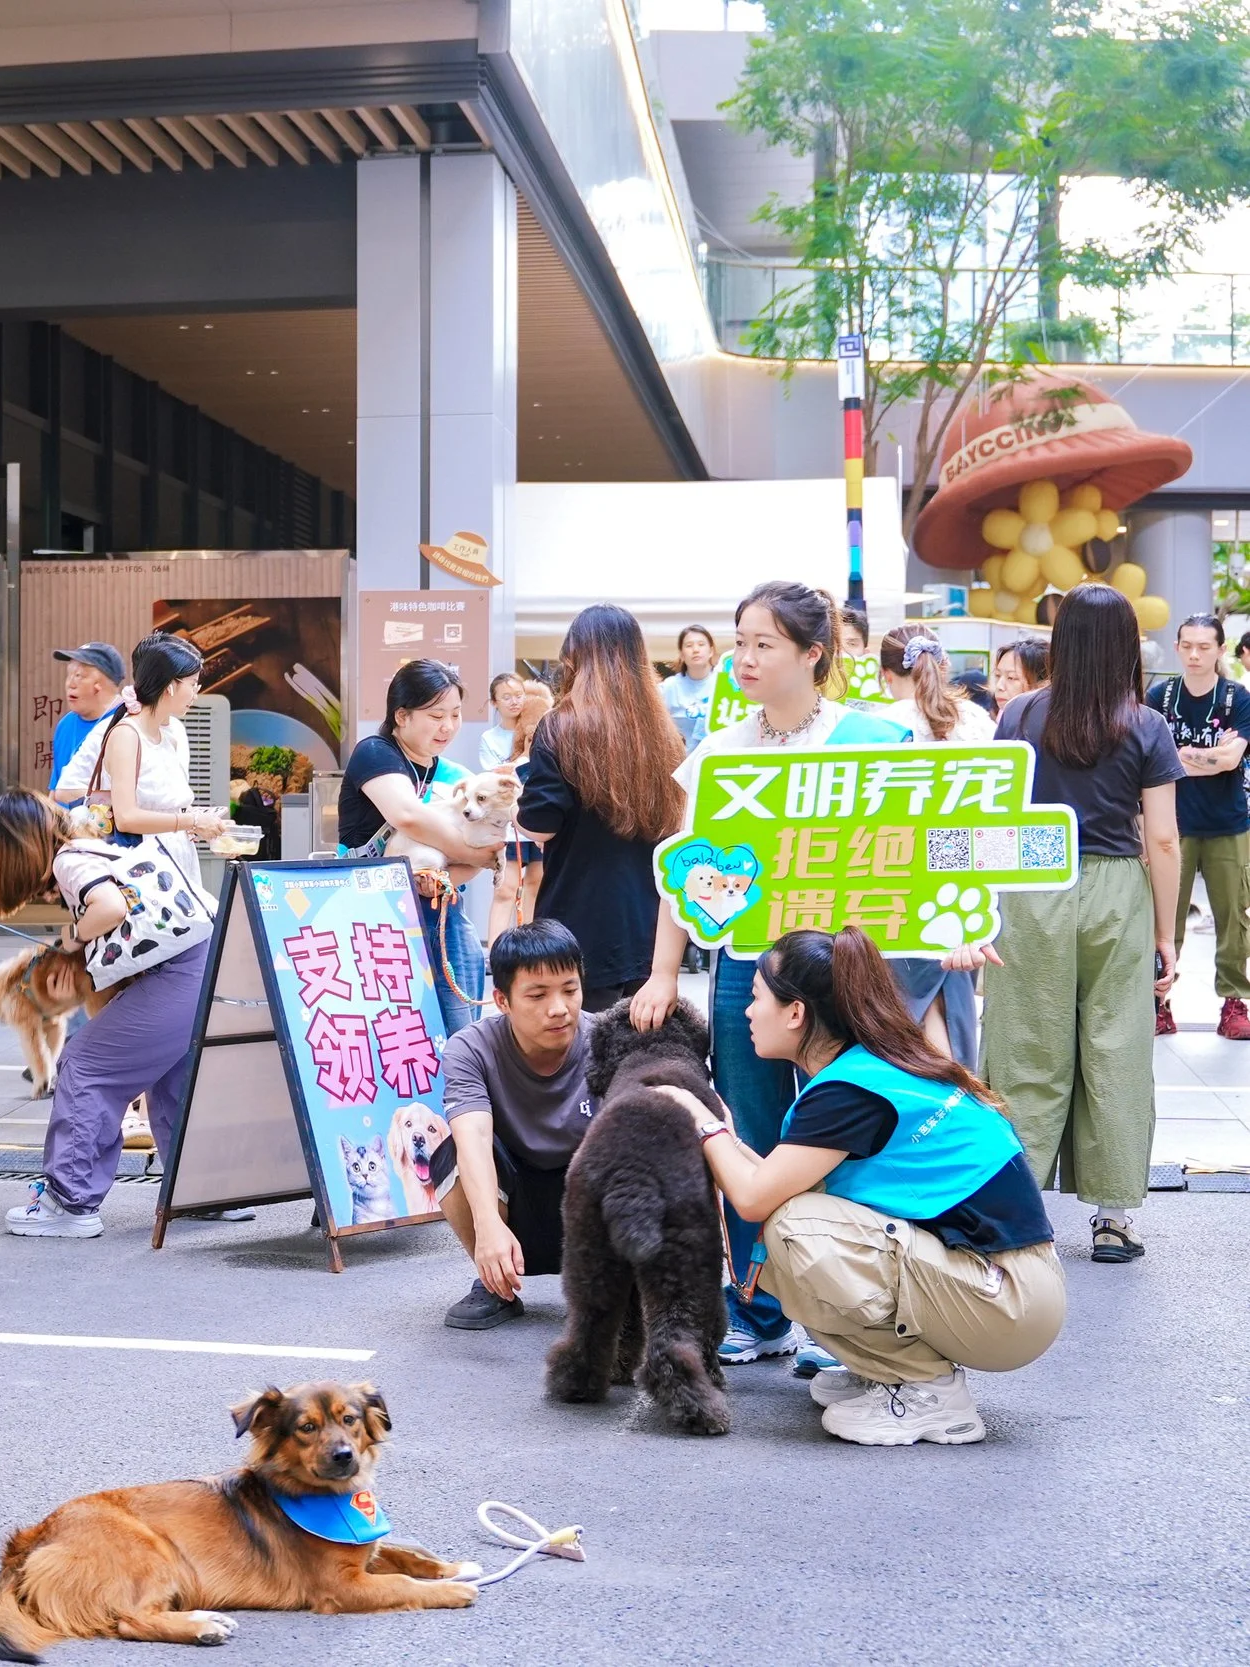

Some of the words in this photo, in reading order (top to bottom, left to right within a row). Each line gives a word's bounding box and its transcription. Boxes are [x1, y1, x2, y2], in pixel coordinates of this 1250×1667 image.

[710, 758, 1015, 821] 文明养宠
[771, 825, 917, 880] 拒绝
[766, 888, 913, 942] 遗弃
[283, 922, 414, 1009] 支持
[305, 1005, 442, 1104] 领养
